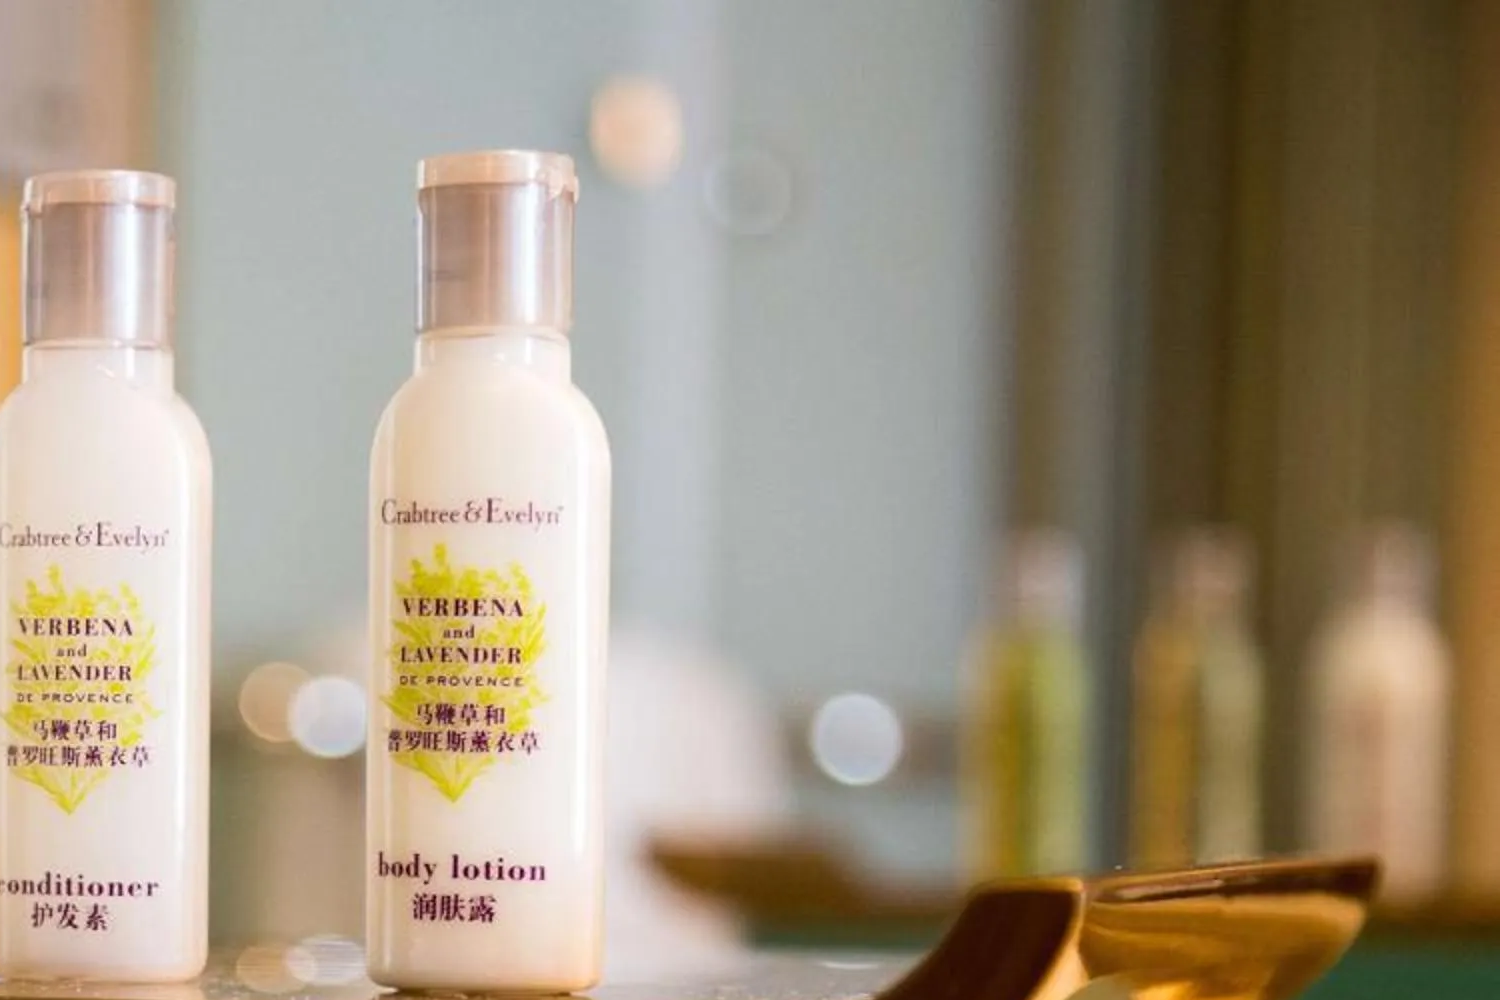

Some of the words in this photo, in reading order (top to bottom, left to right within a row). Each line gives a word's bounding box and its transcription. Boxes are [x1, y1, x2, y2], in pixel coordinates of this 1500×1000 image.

[382, 499, 460, 524] Crabtree
[464, 501, 483, 523] &
[486, 498, 558, 531] Evelyn
[75, 525, 93, 547] &
[96, 522, 166, 554] Evelyn
[403, 598, 523, 617] VERBENA
[19, 618, 133, 636] VERBENA
[443, 625, 475, 639] and
[56, 644, 87, 657] and
[401, 647, 521, 663] LAVENDER
[17, 664, 132, 681] LAVENDER
[400, 676, 418, 686] DE
[426, 676, 524, 686] PROVENCE
[17, 693, 32, 703] DE
[42, 693, 133, 703] PROVENCE
[417, 703, 505, 726] 马鞭草和
[34, 719, 117, 741] 马鞭草和
[378, 852, 437, 885] body
[451, 854, 546, 880] lotion
[31, 903, 109, 930] 护发素
[412, 893, 496, 922] 润肤露
